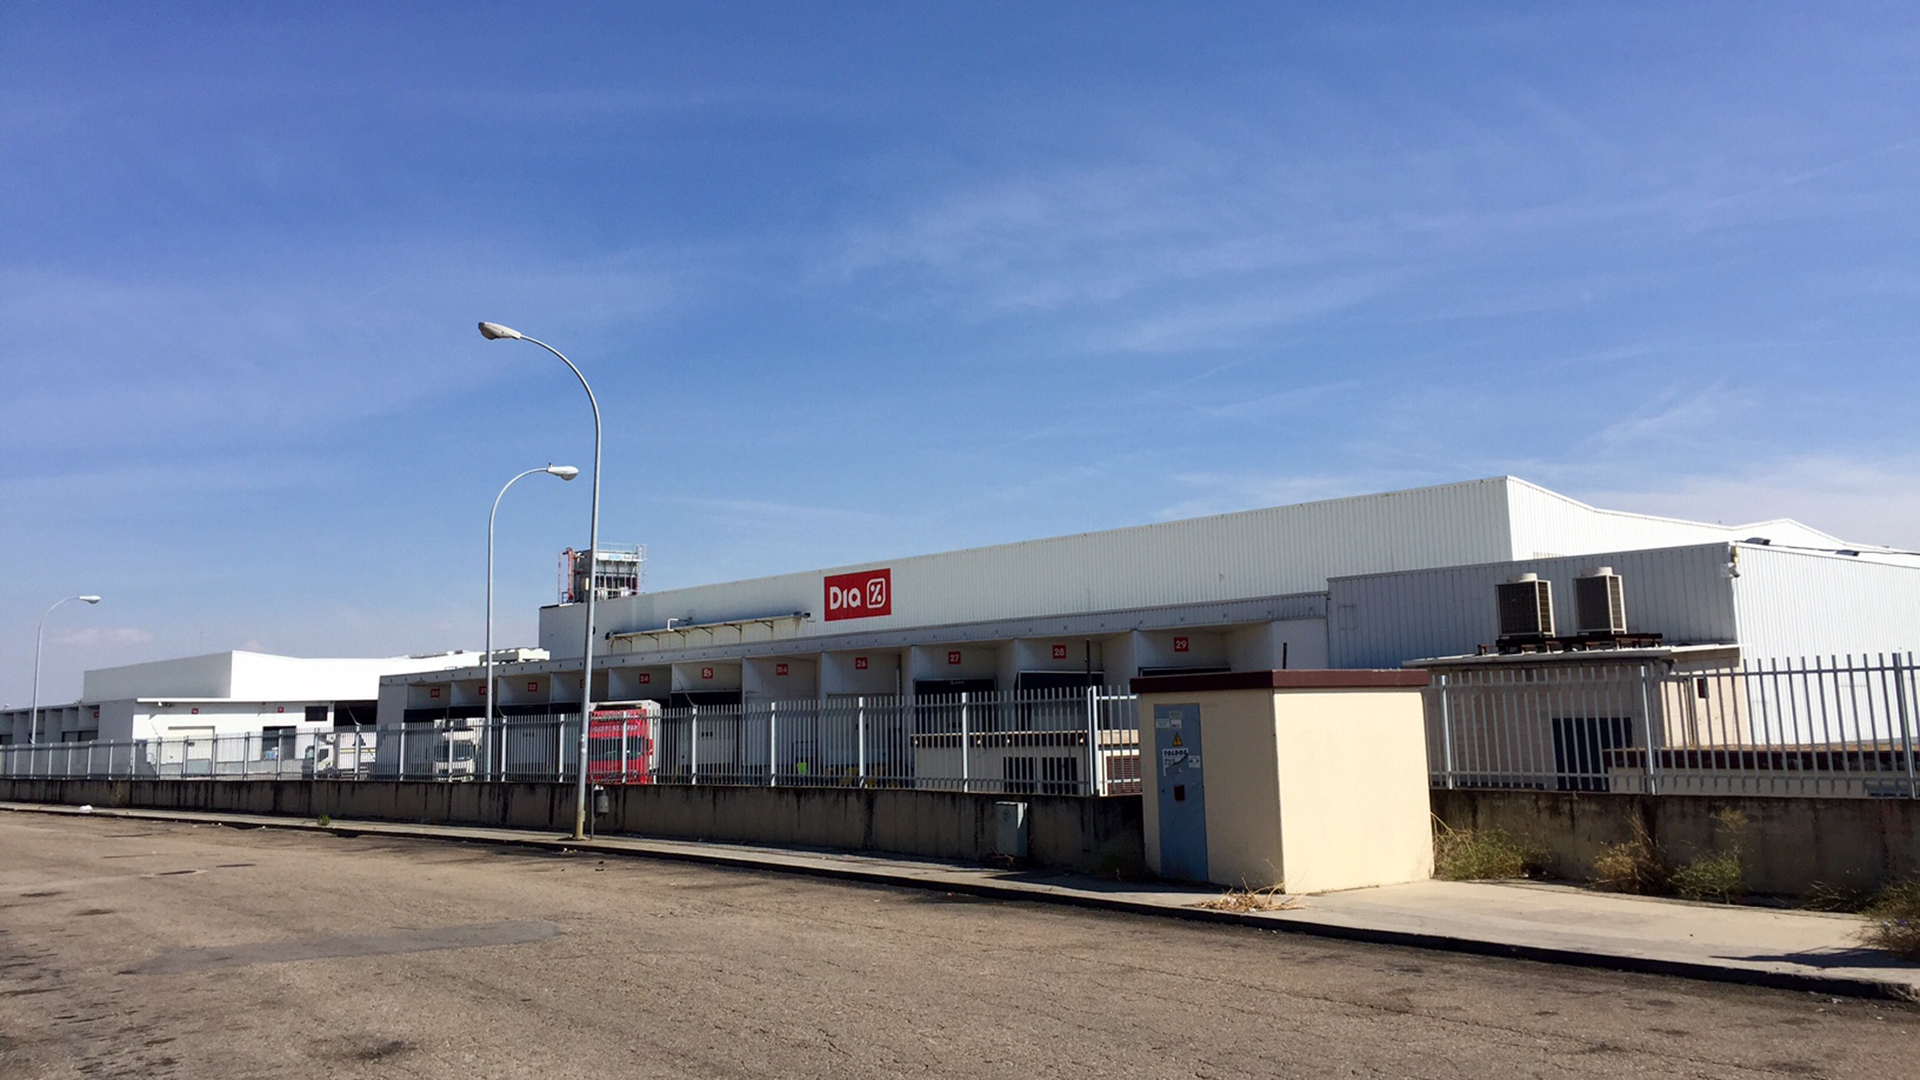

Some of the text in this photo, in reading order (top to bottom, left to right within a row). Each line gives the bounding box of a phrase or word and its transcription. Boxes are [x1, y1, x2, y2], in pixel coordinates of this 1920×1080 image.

[1175, 640, 1187, 649] 29
[1053, 648, 1065, 656] 28
[949, 654, 959, 662] 27
[857, 660, 867, 668] 26
